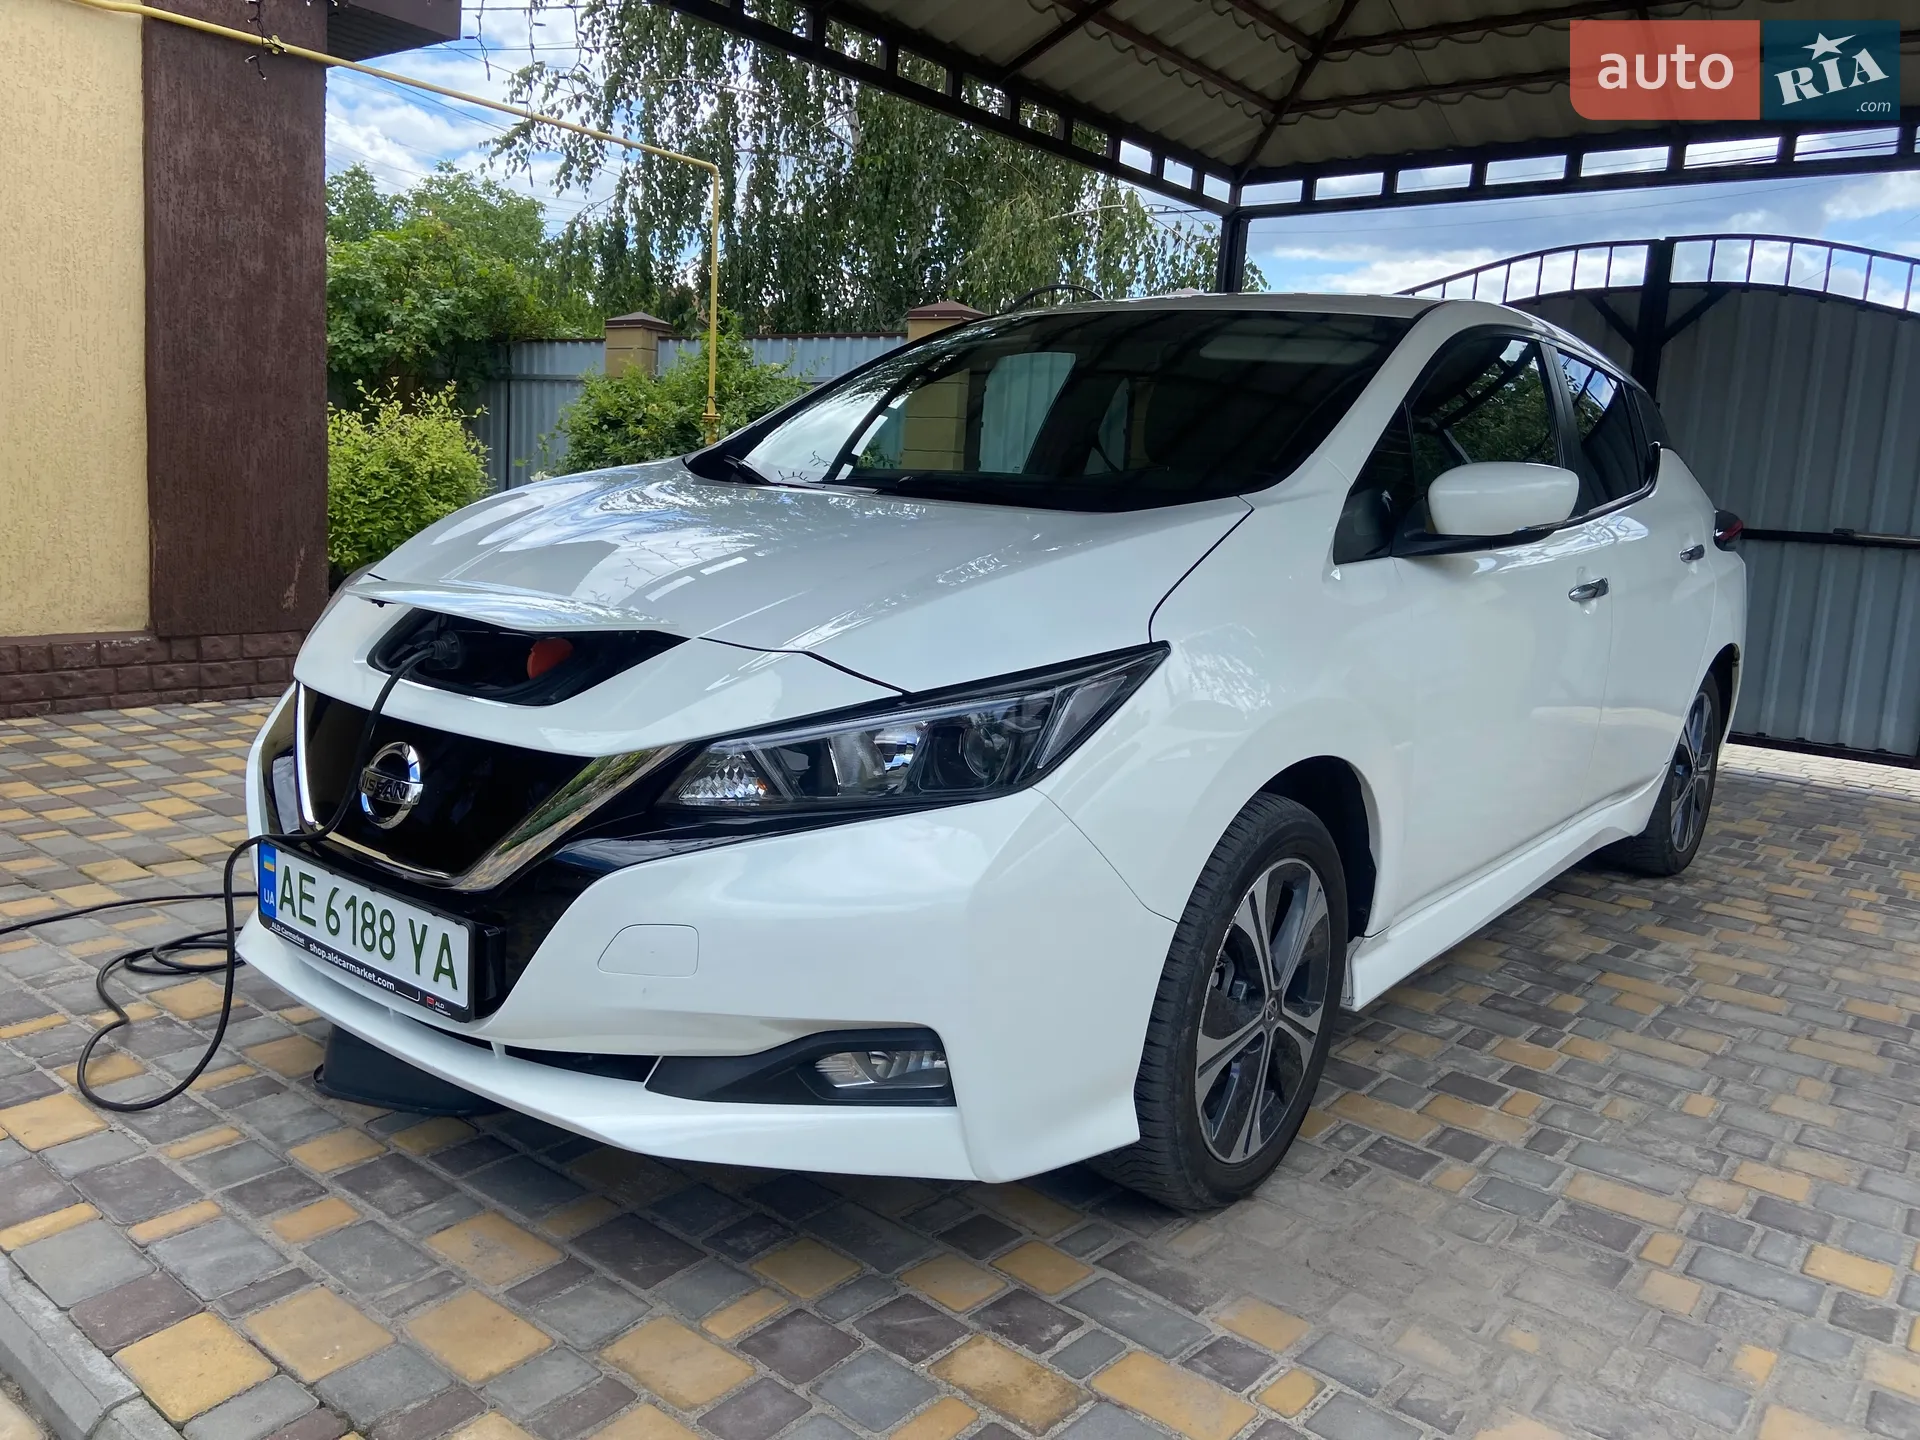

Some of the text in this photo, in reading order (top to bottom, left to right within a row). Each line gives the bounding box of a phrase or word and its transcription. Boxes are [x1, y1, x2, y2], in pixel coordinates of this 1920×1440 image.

[263, 887, 275, 907] UA
[279, 865, 458, 991] AE 6188 YA
[281, 926, 306, 945] Carmarket
[309, 942, 395, 991] shop.aldcarmarket.com
